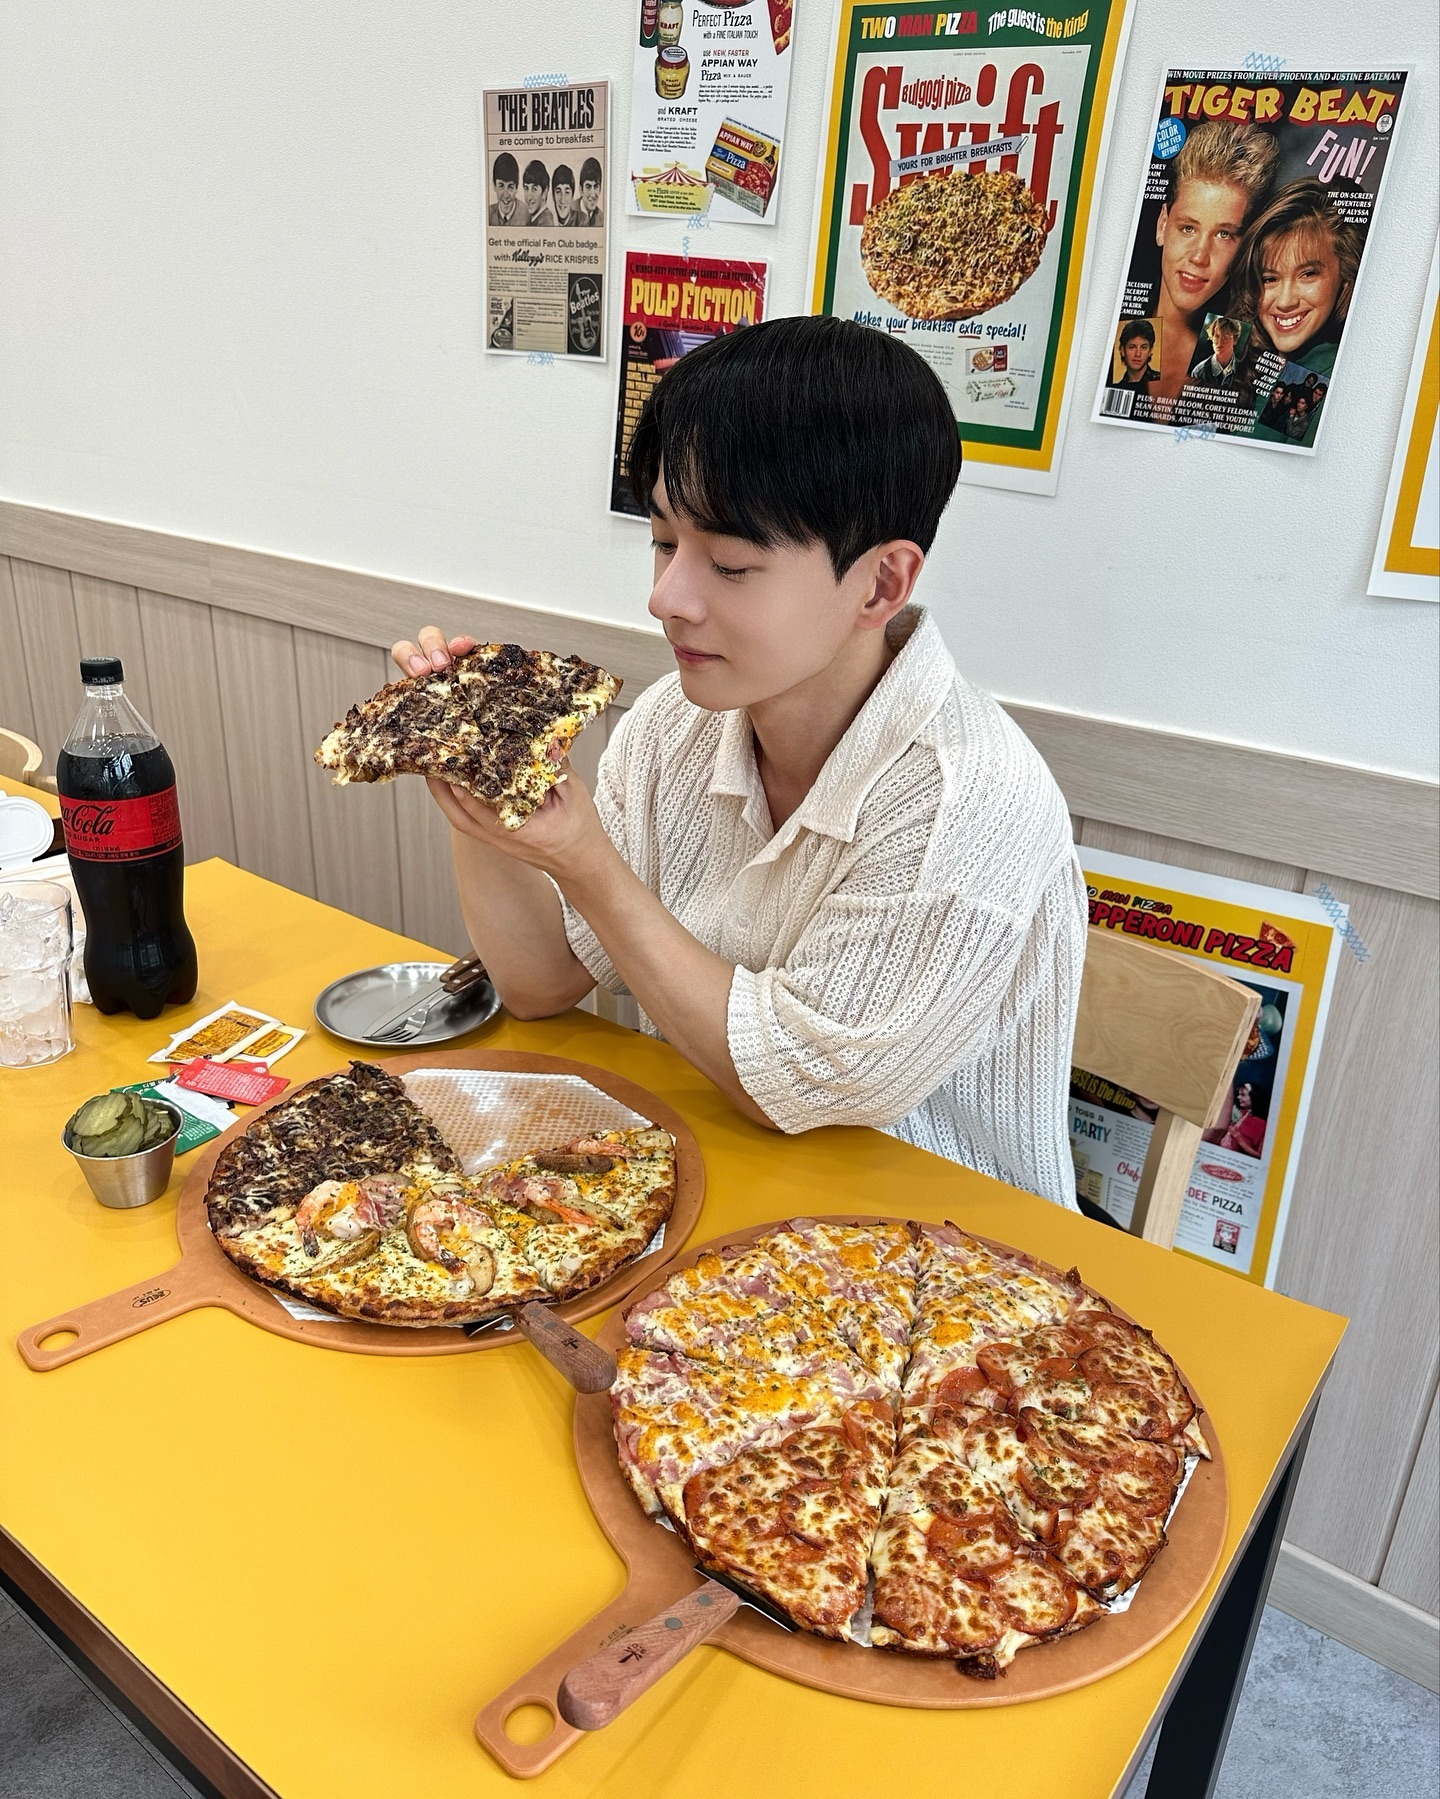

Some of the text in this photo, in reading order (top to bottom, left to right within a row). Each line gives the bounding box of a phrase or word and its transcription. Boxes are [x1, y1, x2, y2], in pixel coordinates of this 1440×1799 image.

[692, 10, 752, 27] PERFECT Pizza
[862, 11, 978, 39] TWO MAN PIZZA
[988, 8, 1090, 38] The guest is the king
[703, 31, 711, 39] with
[717, 31, 726, 39] FINE
[727, 31, 743, 39] ITALIAN
[744, 31, 759, 39] TOUCH
[701, 59, 735, 67] APPIAN
[701, 70, 721, 81] Pizza
[1182, 71, 1206, 79] MOVIE
[1206, 71, 1232, 80] PRIZES
[1233, 72, 1255, 80] FROM
[1256, 72, 1278, 80] RIVER
[902, 75, 971, 110] Bulgogi pizza
[498, 88, 594, 132] THE BEATLES
[669, 107, 698, 115] KRAFT
[1165, 84, 1282, 121] TIGER
[1289, 87, 1396, 124] BEAT
[1156, 124, 1179, 142] COLOR
[1159, 119, 1172, 130] MORE
[514, 136, 544, 146] coming
[556, 134, 594, 144] breakfast
[719, 131, 753, 151] APPIAN WAY
[1157, 134, 1182, 150] THAN EVER
[726, 152, 746, 170] Pizza
[898, 142, 1012, 171] YOURS FOR BRIGHTER BREAKFASTS
[1306, 129, 1377, 185] FUN!
[488, 238, 503, 247] Get
[517, 239, 541, 247] official
[542, 240, 556, 248] Fan
[558, 240, 574, 248] Club
[512, 249, 544, 267] Kellogg's
[545, 255, 562, 263] RICE
[564, 255, 599, 264] KRISPIES
[569, 292, 600, 314] Beatles
[630, 278, 756, 326] PULP FICTION
[853, 311, 1027, 341] Makes your breakfast extra special!
[1257, 356, 1282, 370] FRIENDLY
[1263, 351, 1286, 364] GETTING
[1255, 364, 1280, 378] WITH THE
[1261, 375, 1277, 384] JUMP
[1183, 385, 1210, 394] THROUGH
[1252, 379, 1273, 390] STREET
[1256, 388, 1270, 398] CAST
[1157, 396, 1177, 405] BRIAN
[1178, 400, 1204, 410] BLOOM,
[1205, 404, 1227, 412] COREY
[1227, 406, 1259, 418] FELDMAN,
[1213, 396, 1237, 404] PHOENIX
[1149, 412, 1177, 422] AWARDS,
[1178, 416, 1193, 424] AND
[1152, 405, 1173, 414] ASTIN,
[1175, 408, 1190, 416] TREY
[1191, 410, 1211, 419] AMES,
[1226, 416, 1247, 424] YOUTH
[74, 834, 100, 842] SUGAR
[1099, 890, 1131, 905] MAN
[1132, 896, 1173, 915] PIZZA
[1203, 928, 1294, 973] PIZZA
[1097, 1080, 1114, 1100] the
[1113, 1090, 1136, 1109] king
[1075, 1106, 1094, 1119] toss
[1073, 1117, 1112, 1143] PARTY
[1212, 1195, 1243, 1215] PIZZA
